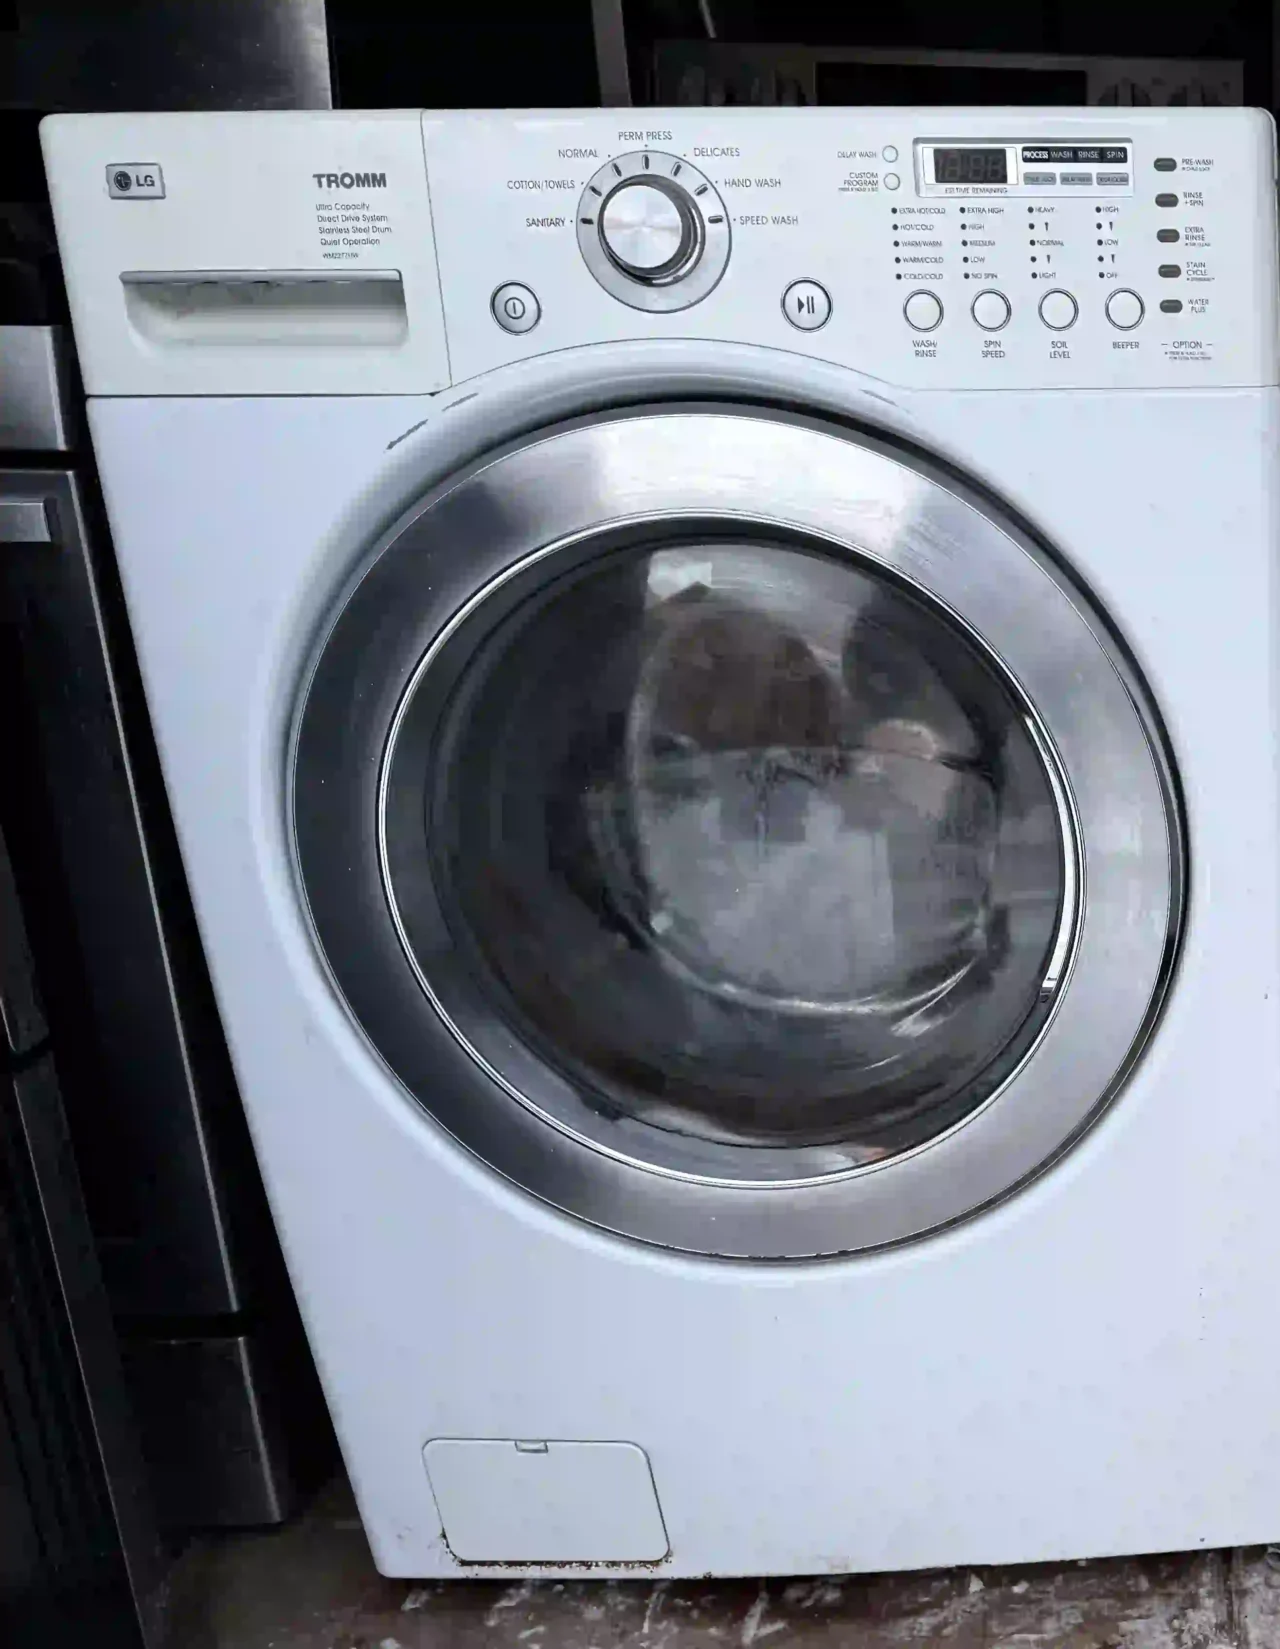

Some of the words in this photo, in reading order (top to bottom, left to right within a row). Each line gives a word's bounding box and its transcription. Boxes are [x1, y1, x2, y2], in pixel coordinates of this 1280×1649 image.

[619, 132, 643, 140] PERM
[647, 131, 672, 140] PRESS
[558, 149, 598, 158] NORMAL
[694, 148, 740, 157] DELICATES
[136, 175, 155, 187] LG
[313, 172, 387, 188] TROMM
[725, 179, 751, 187] HAND
[755, 179, 781, 187] WASH
[507, 180, 575, 191] COTTON/TOWELS
[334, 202, 370, 211] Capacity
[341, 214, 360, 222] Drive
[362, 214, 388, 222] System
[526, 218, 565, 227] SANITARY
[740, 216, 768, 225] SPEED
[771, 216, 798, 224] WASH
[342, 237, 380, 247] Operation
